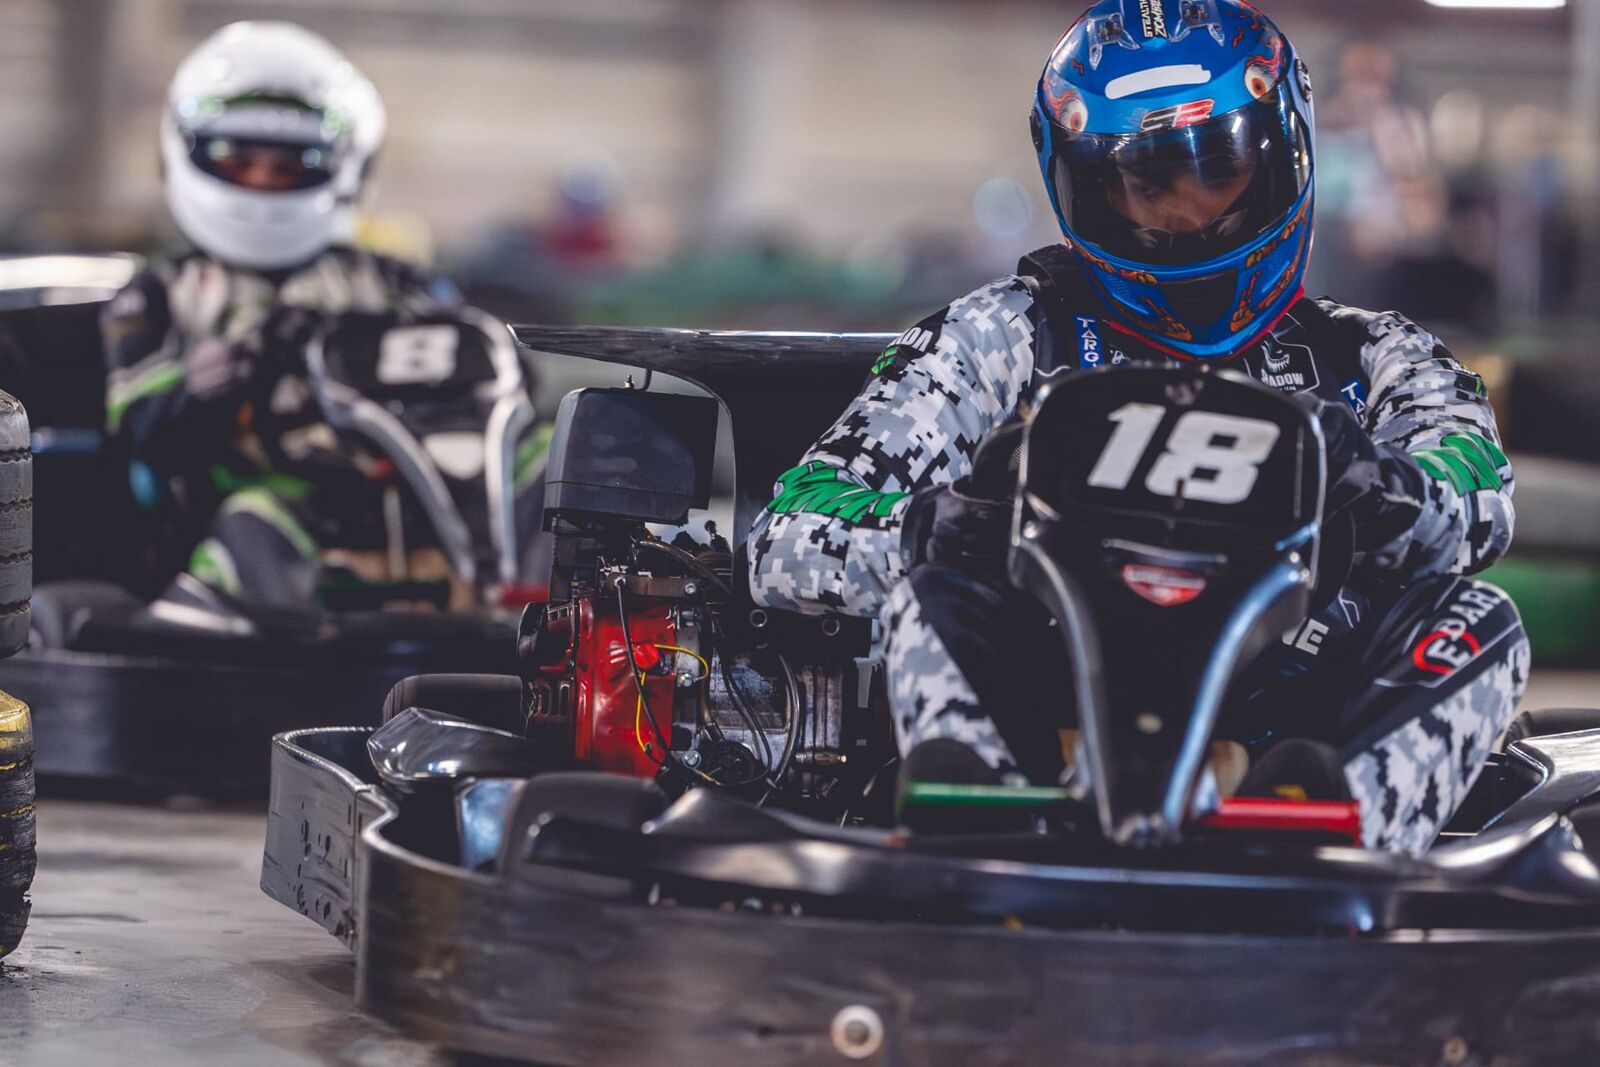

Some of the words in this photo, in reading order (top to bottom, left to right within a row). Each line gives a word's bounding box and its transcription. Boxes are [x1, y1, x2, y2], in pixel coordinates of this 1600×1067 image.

[377, 324, 460, 385] 8
[1076, 317, 1100, 368] TARG
[1087, 402, 1281, 504] 18
